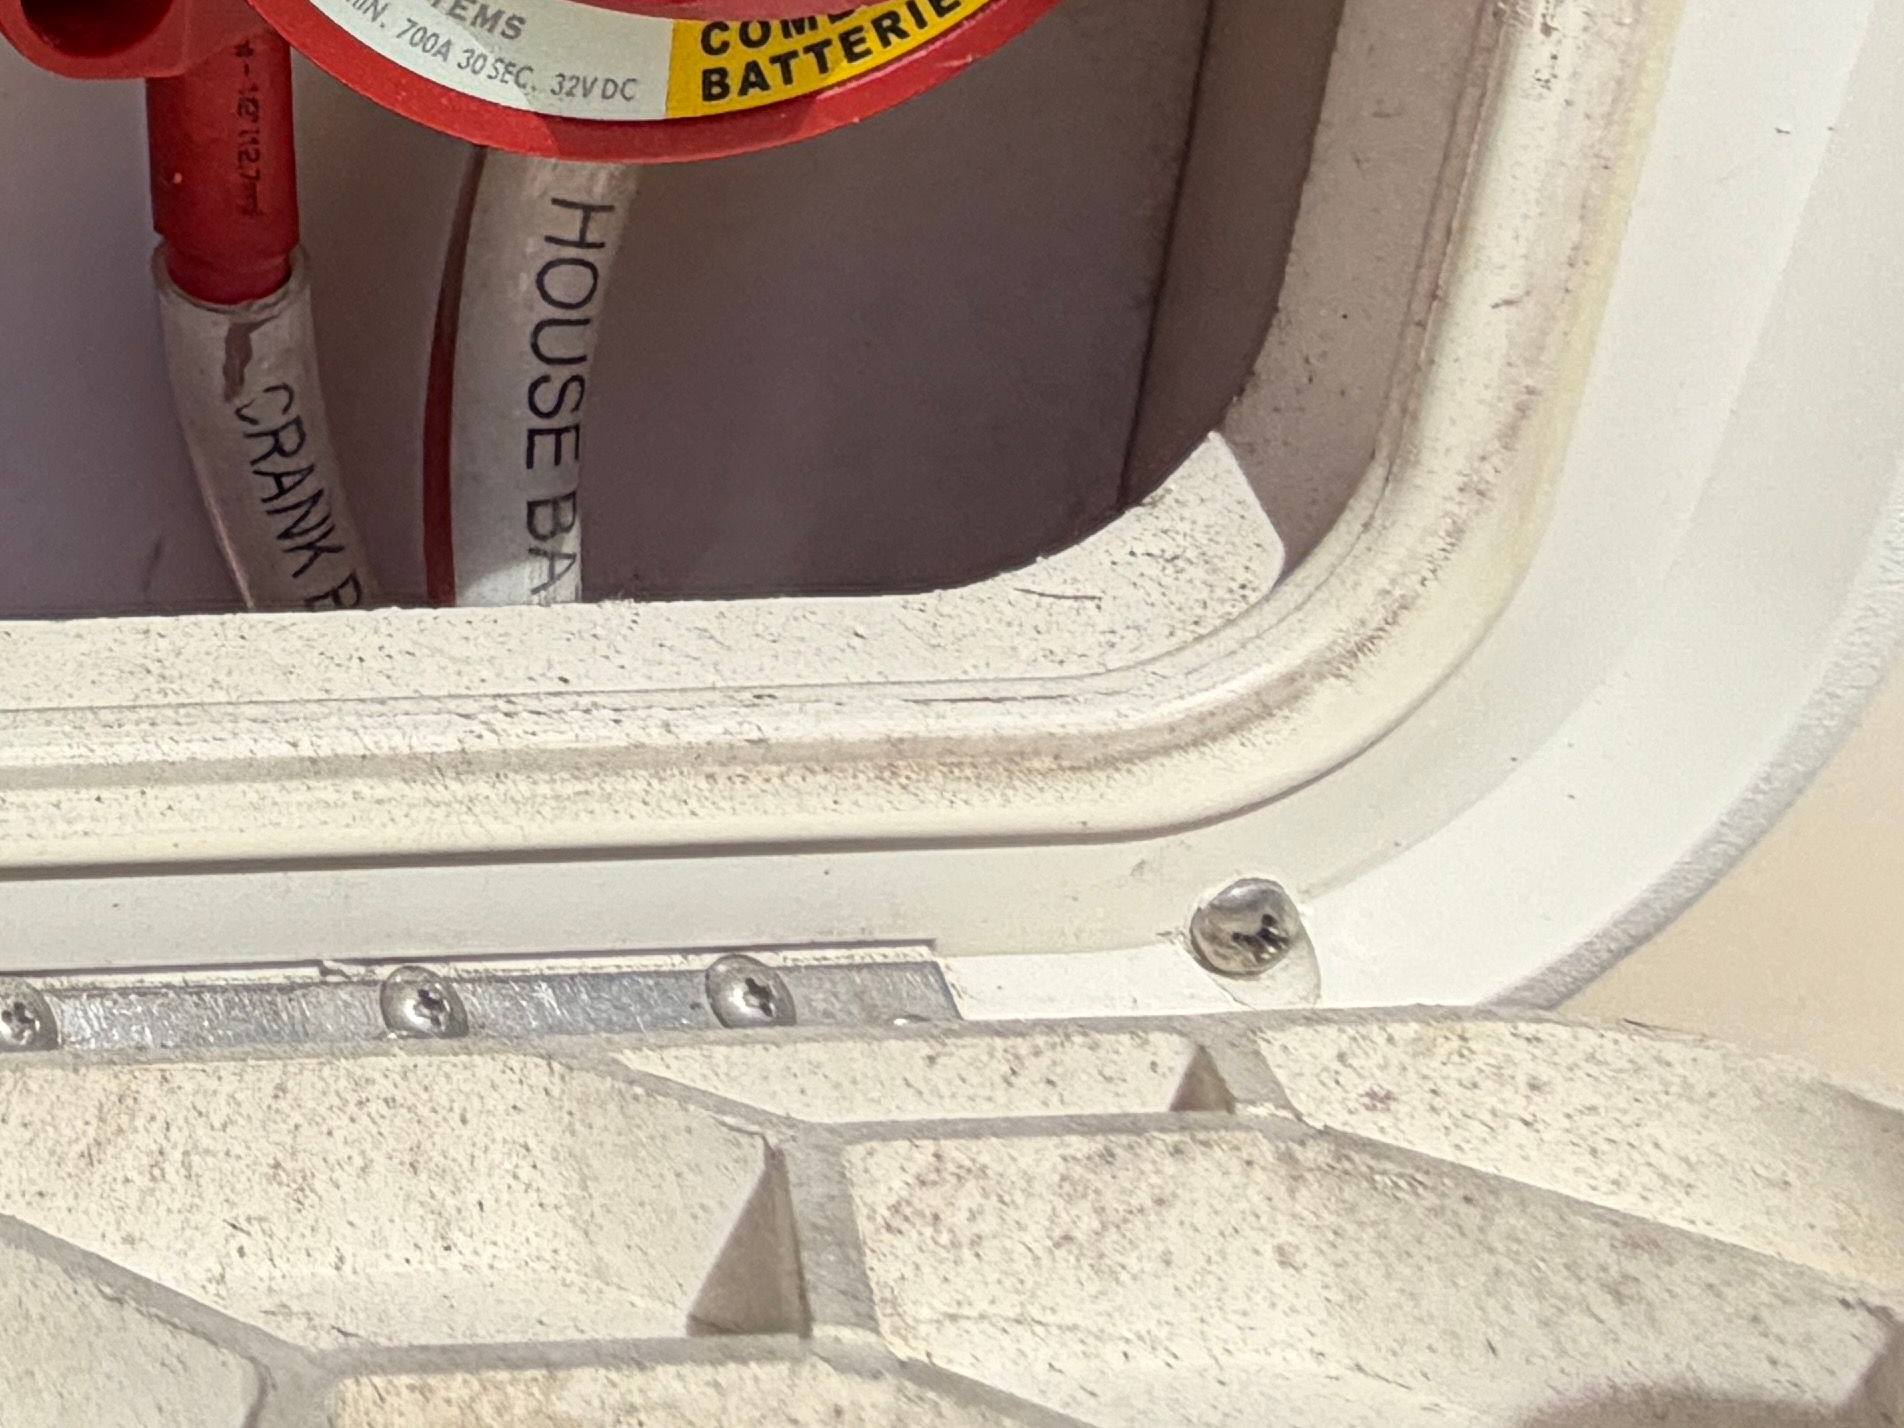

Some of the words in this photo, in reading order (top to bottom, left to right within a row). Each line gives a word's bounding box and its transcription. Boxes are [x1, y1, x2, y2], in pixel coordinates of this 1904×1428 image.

[395, 17, 453, 63] 700A
[526, 195, 616, 470] HOUSE
[235, 381, 346, 579] CRANK
